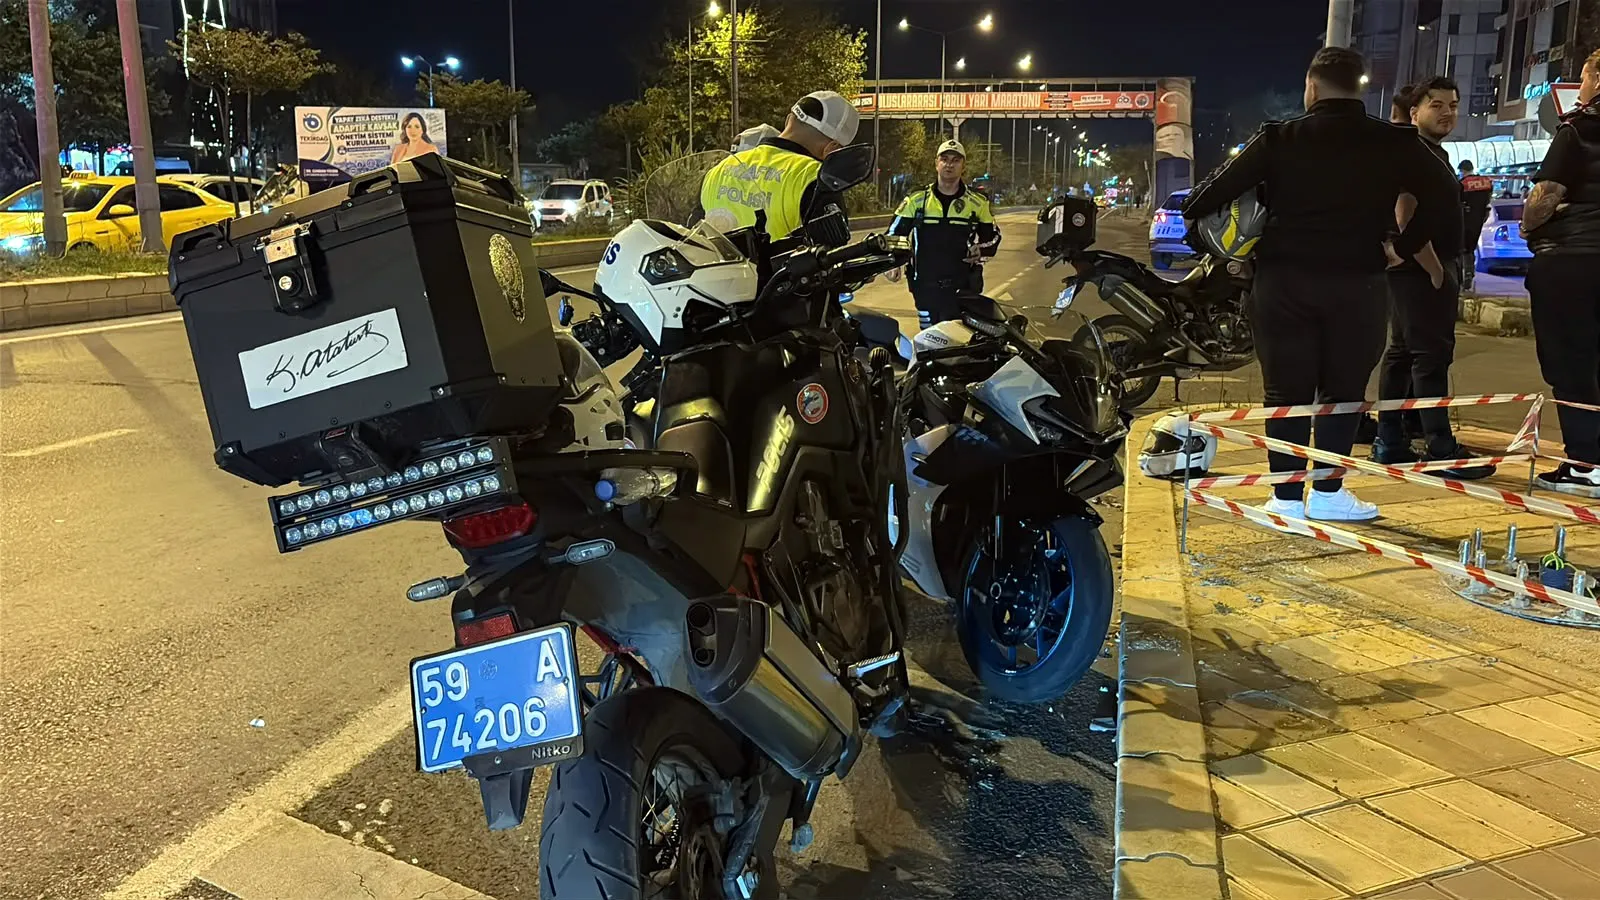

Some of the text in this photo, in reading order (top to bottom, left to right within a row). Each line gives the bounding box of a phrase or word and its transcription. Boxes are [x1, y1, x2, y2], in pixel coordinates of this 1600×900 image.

[968, 94, 988, 108] YARI
[991, 93, 1041, 108] MARATONU
[421, 639, 563, 707] 59 A
[426, 697, 548, 761] 74206
[531, 745, 571, 760] Nitko
